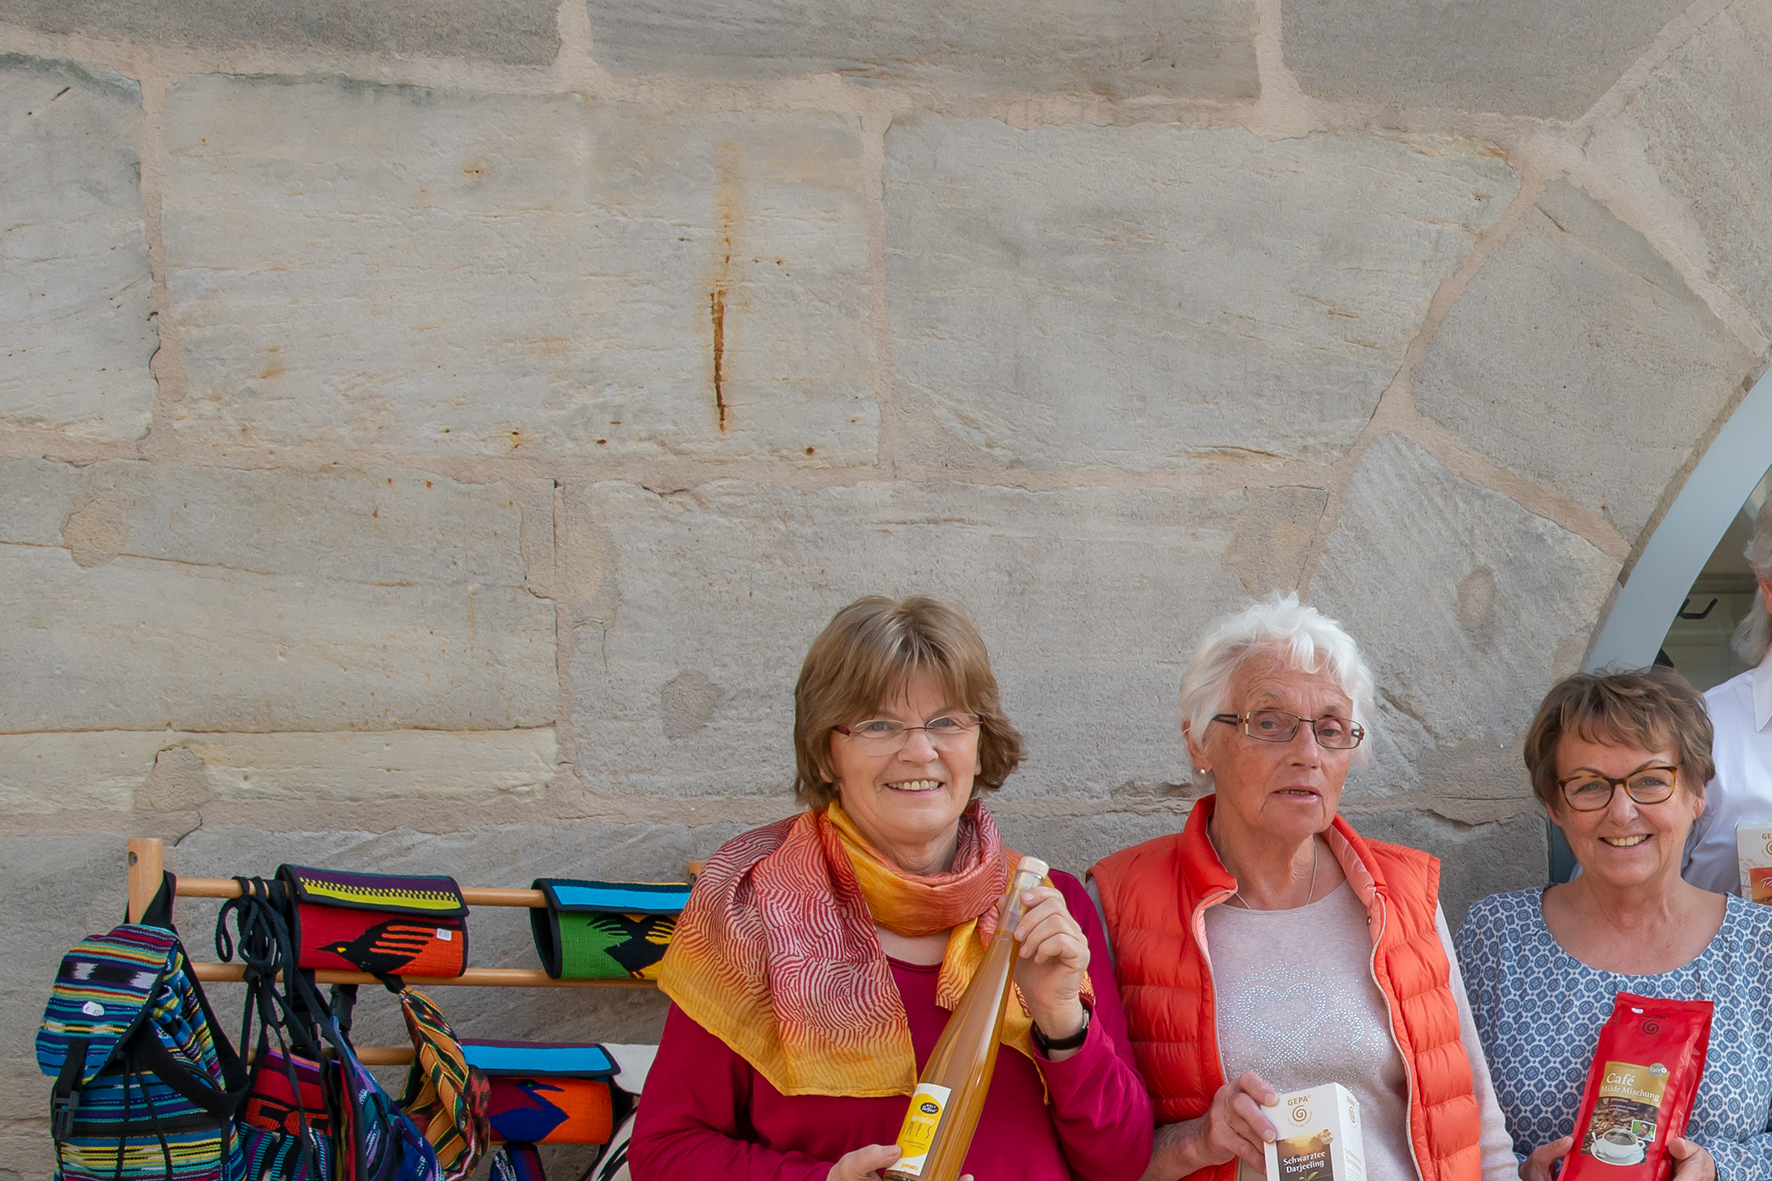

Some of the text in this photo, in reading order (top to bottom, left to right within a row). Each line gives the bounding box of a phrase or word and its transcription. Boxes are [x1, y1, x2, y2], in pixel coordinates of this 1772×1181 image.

[1606, 1072, 1635, 1087] Café
[1600, 1085, 1660, 1103] Milde Mischung
[911, 1115, 935, 1125] MANGO
[1283, 1151, 1326, 1166] Schwarztee
[1286, 1160, 1325, 1174] Darjeeling
